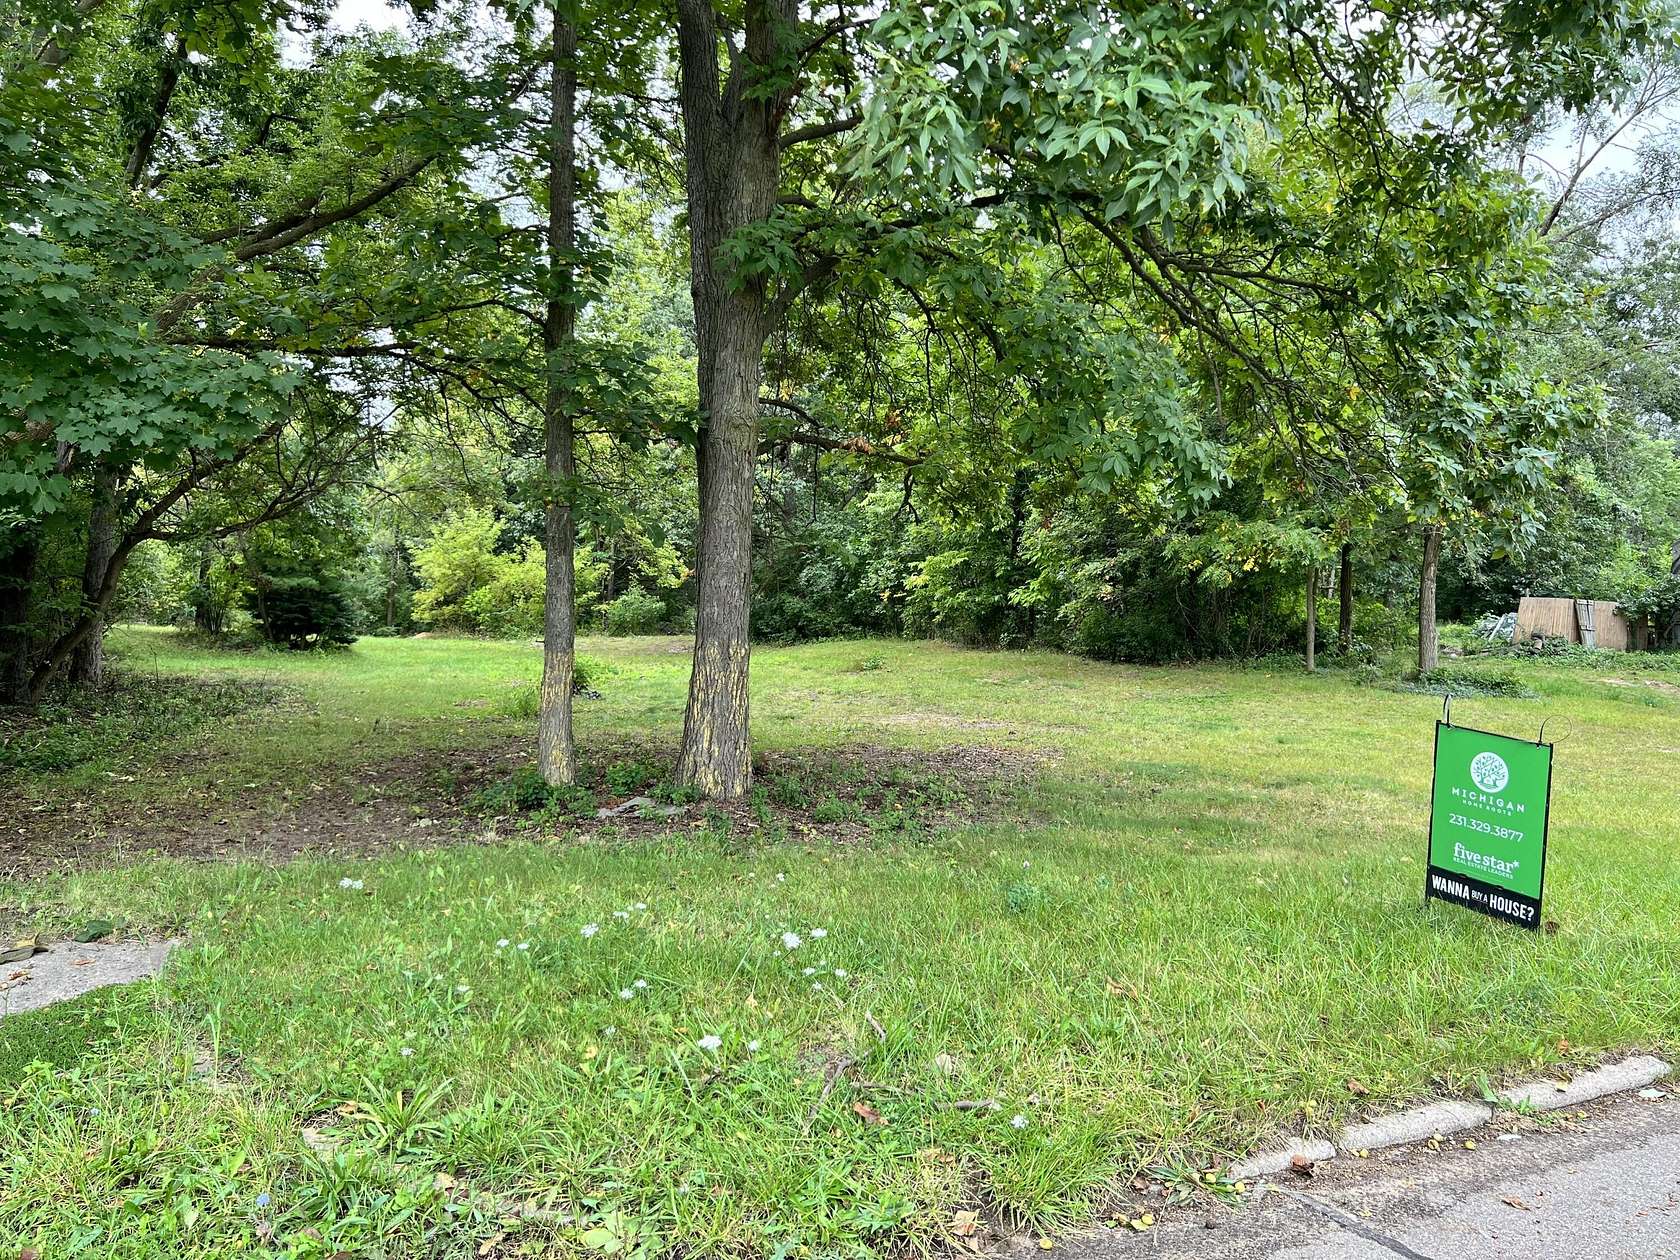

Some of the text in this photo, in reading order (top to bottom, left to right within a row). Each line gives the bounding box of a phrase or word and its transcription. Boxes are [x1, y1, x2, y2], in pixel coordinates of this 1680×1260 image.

[1452, 787, 1525, 813] MICHIGAN
[1463, 799, 1482, 809] HOME
[1449, 813, 1523, 842] 231.329.3877
[1453, 842, 1481, 864] five
[1453, 857, 1466, 866] REAL
[1467, 861, 1487, 872] ESTATE
[1487, 866, 1513, 880] LEADERS
[1431, 874, 1470, 900] WANNA
[1471, 889, 1483, 901] BUY
[1483, 895, 1488, 903] A
[1489, 894, 1535, 921] HOUSE?
